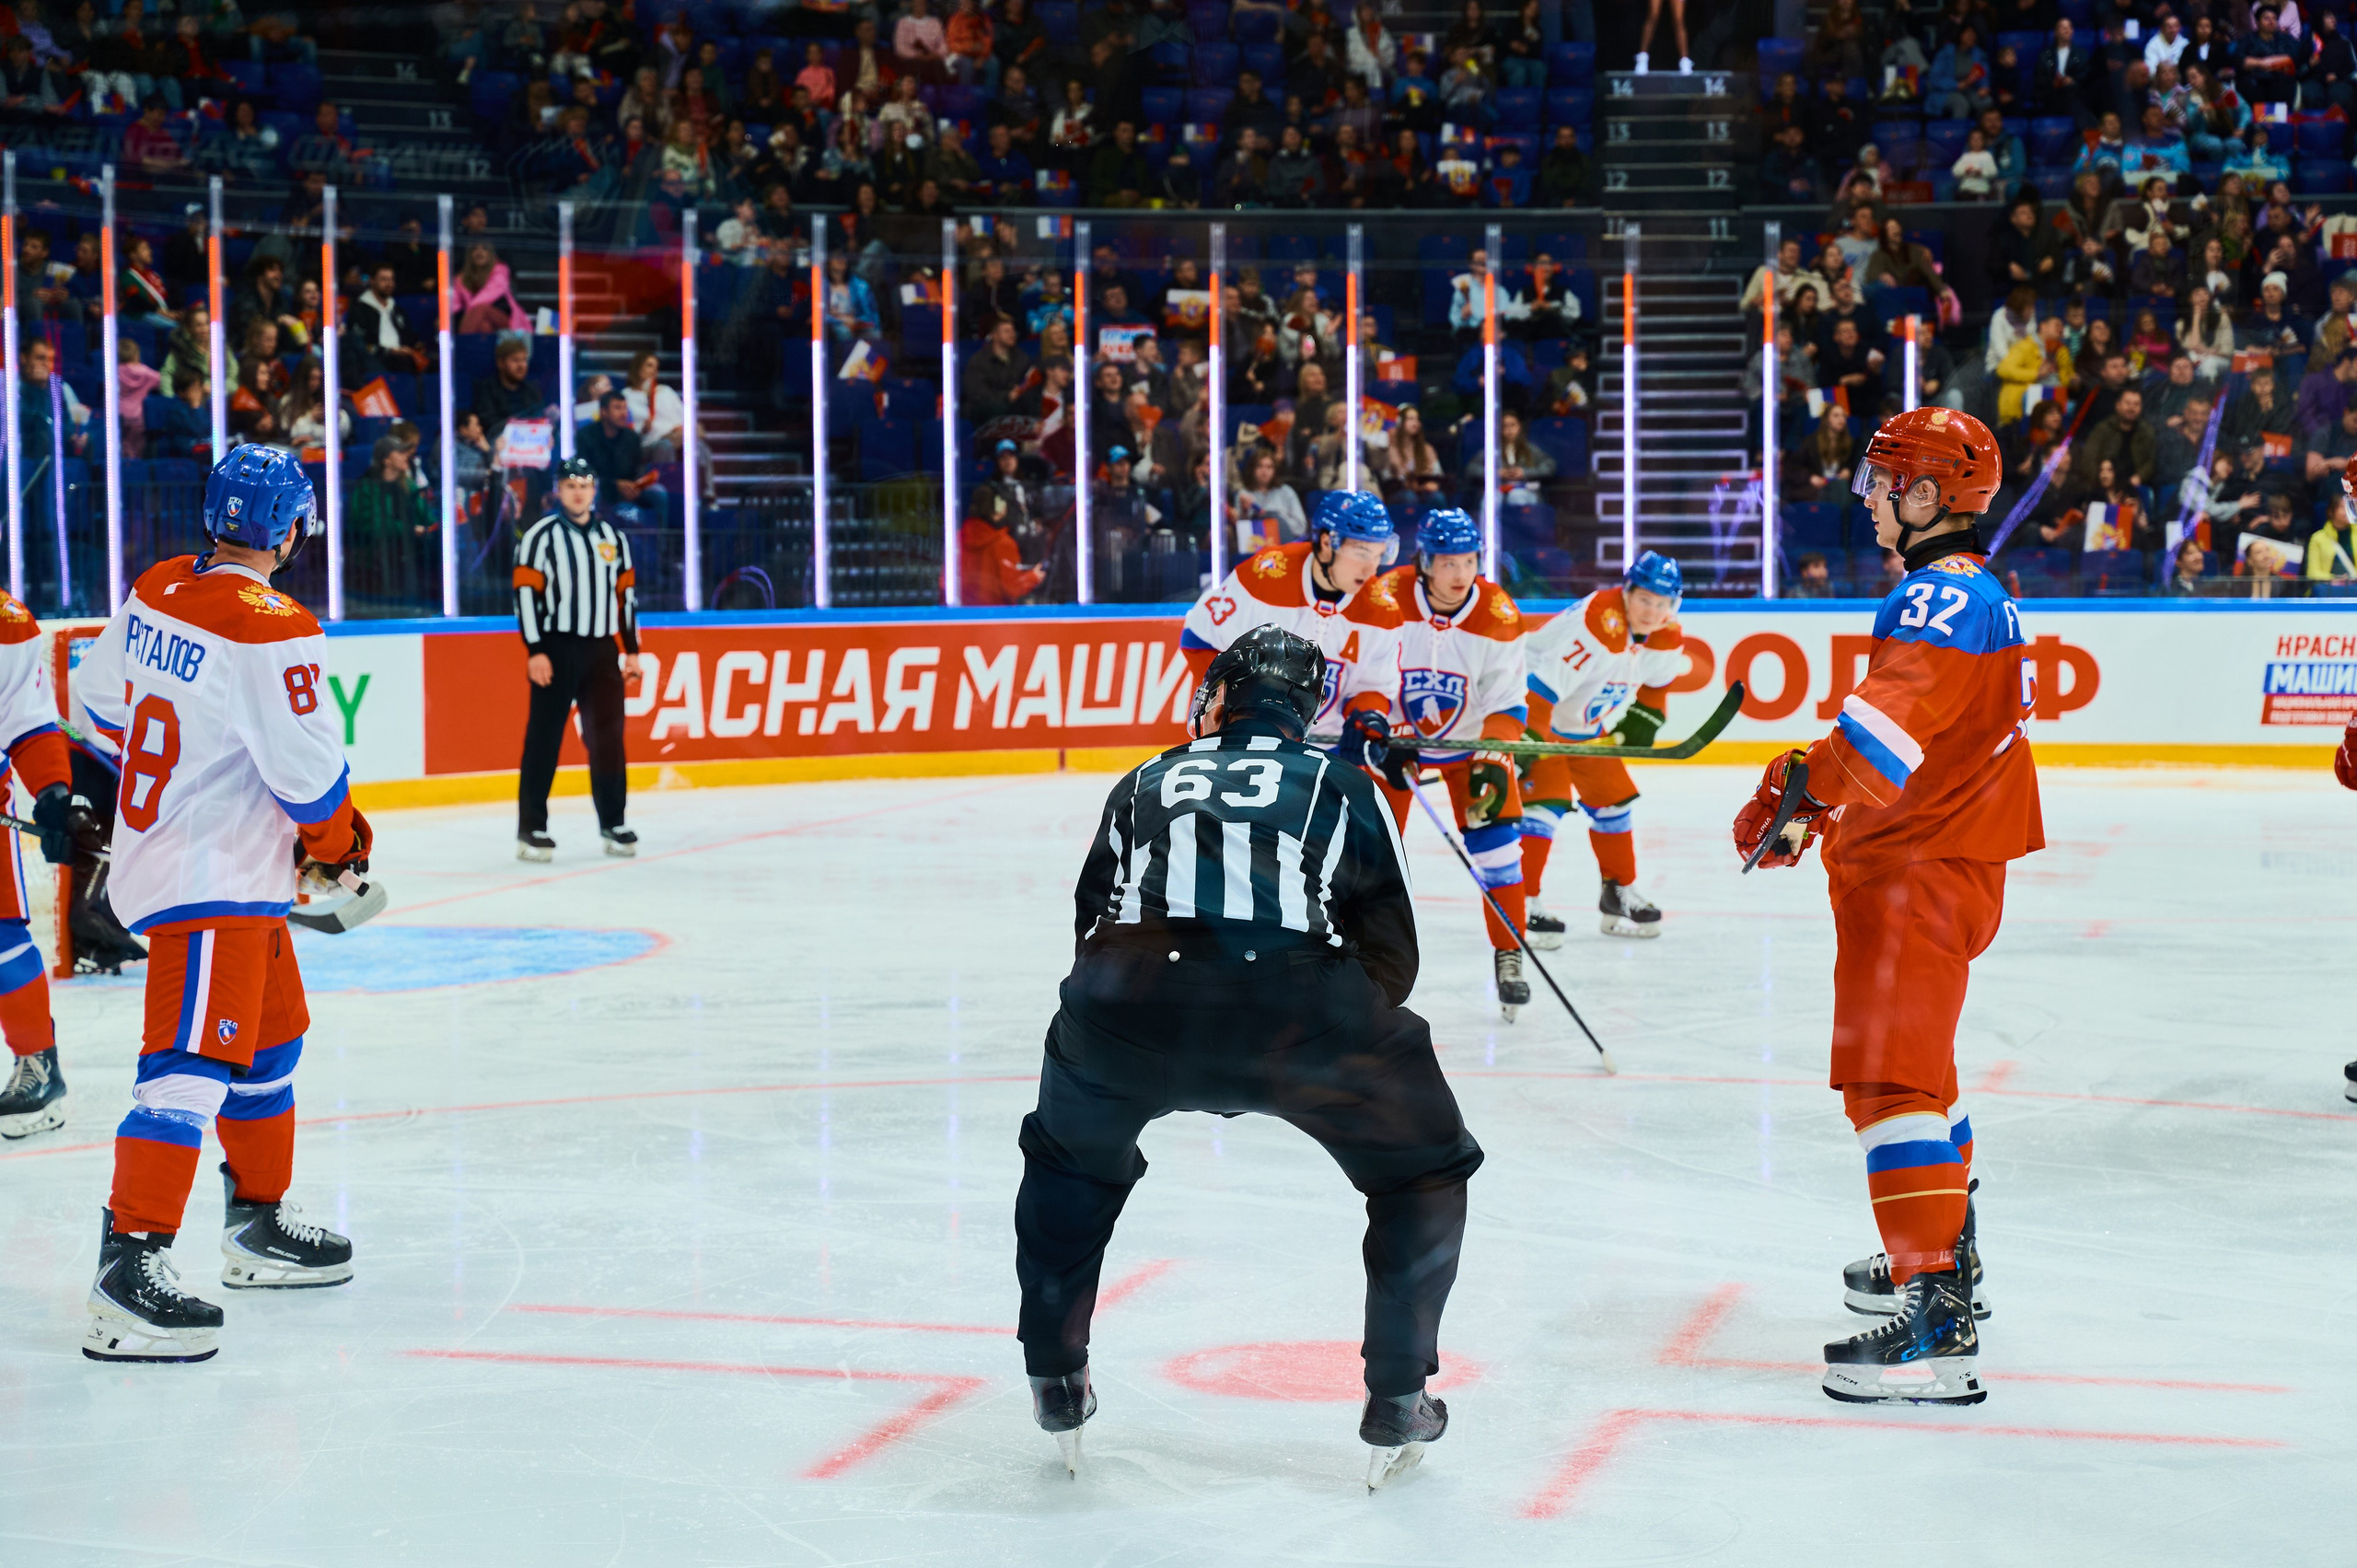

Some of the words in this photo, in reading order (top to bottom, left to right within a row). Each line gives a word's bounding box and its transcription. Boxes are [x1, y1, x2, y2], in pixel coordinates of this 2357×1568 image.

[1899, 583, 1969, 637] 32
[1562, 638, 1592, 671] 71
[2275, 633, 2357, 657] КРАСН
[573, 646, 941, 740] РАСНАЯ
[2269, 663, 2357, 694] МАШИ
[1160, 758, 1284, 809] 63
[1900, 1317, 1956, 1362] CCM
